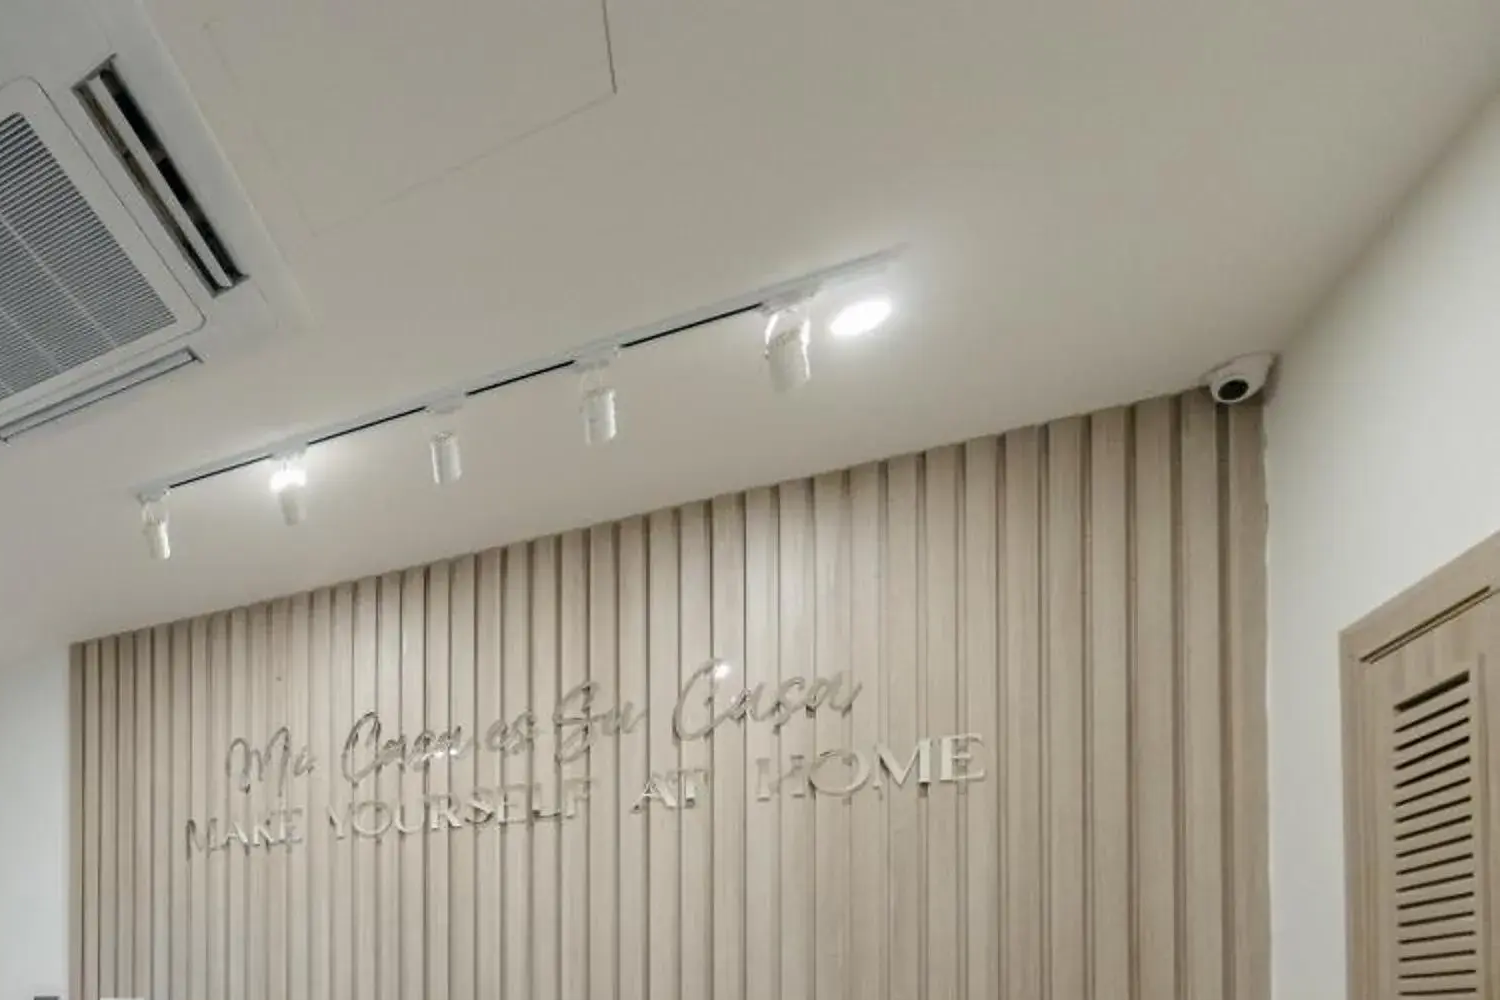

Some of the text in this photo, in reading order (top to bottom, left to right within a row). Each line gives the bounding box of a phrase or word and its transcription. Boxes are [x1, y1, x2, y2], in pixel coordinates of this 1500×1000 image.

[672, 656, 861, 744] Casa
[186, 732, 985, 859] MAKE YOURSELF AT HOME
